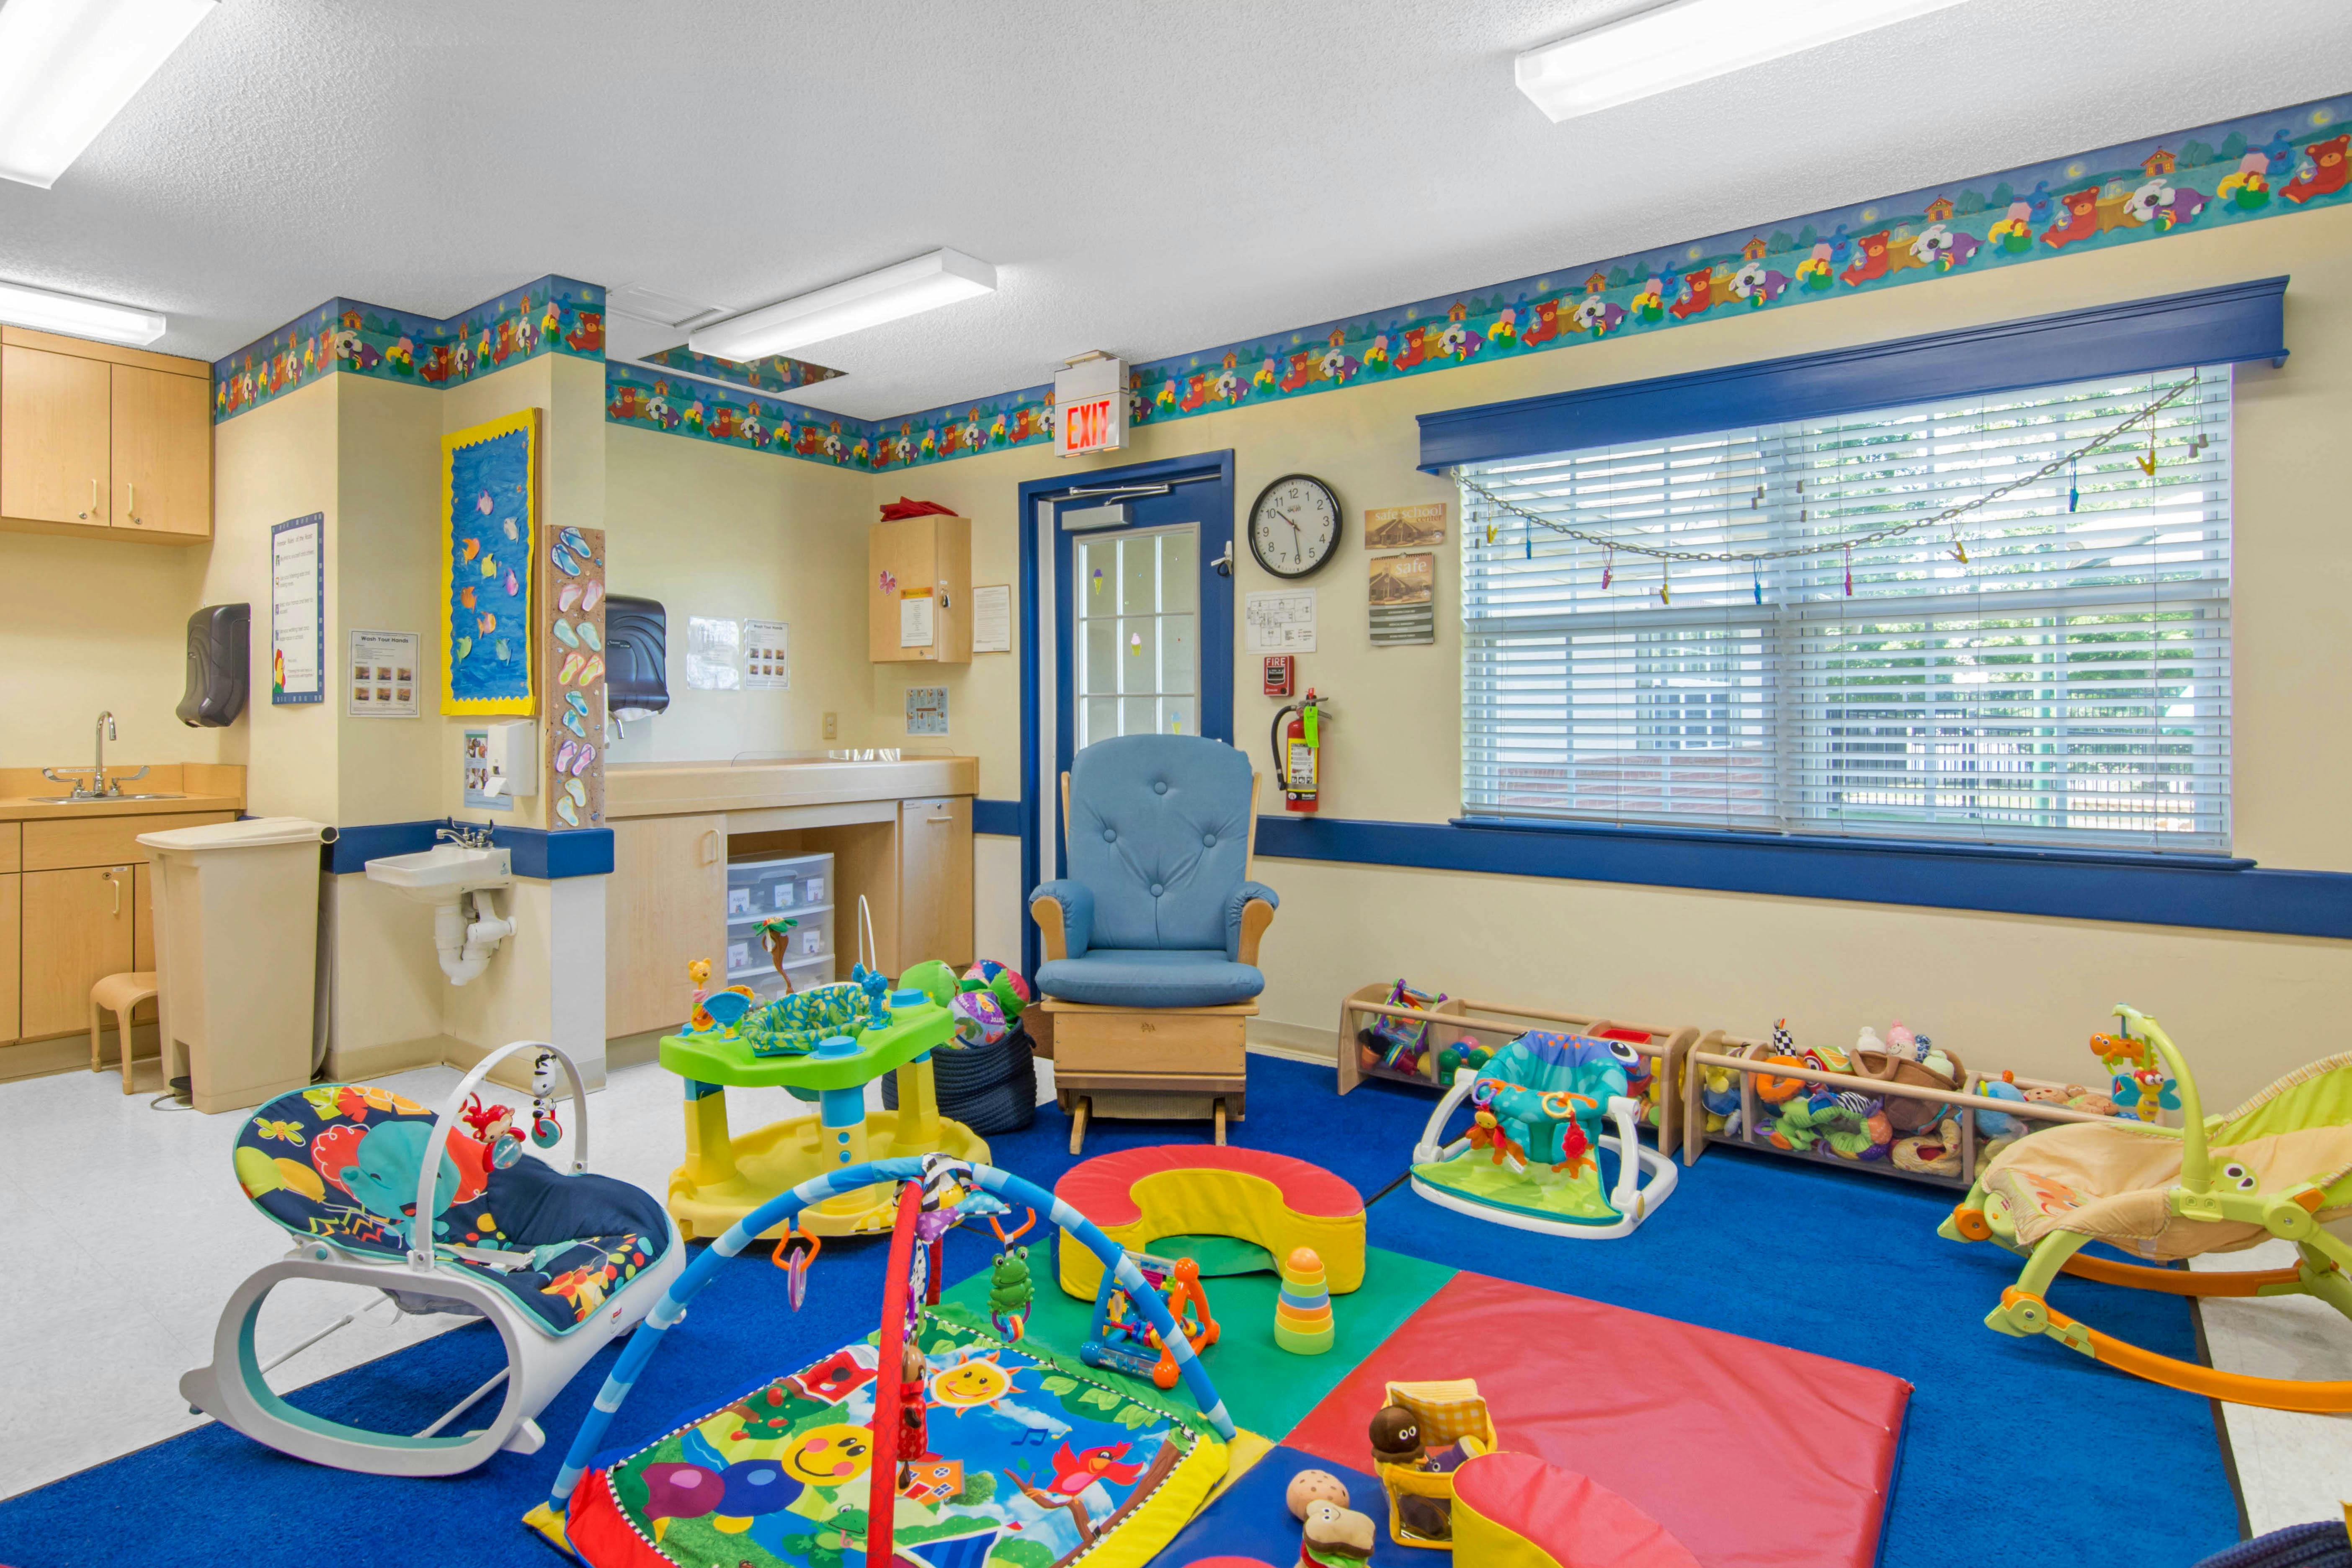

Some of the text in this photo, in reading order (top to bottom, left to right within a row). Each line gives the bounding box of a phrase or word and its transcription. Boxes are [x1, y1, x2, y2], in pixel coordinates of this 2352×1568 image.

[1067, 400, 1110, 450] EXIT
[1288, 488, 1298, 499] 12
[1306, 491, 1310, 501] 1
[1275, 497, 1283, 507] 11
[1317, 500, 1323, 510] 2
[1266, 508, 1276, 519] 10
[1375, 504, 1442, 520] safe school
[1323, 516, 1329, 526] 3
[1263, 527, 1269, 537] 9
[1319, 534, 1325, 544] 4
[1269, 542, 1274, 552] 8
[1280, 552, 1286, 563] 7
[1309, 547, 1315, 558] 5
[1295, 554, 1300, 565] 6
[1396, 557, 1426, 575] safe
[1266, 658, 1286, 666] FIRE
